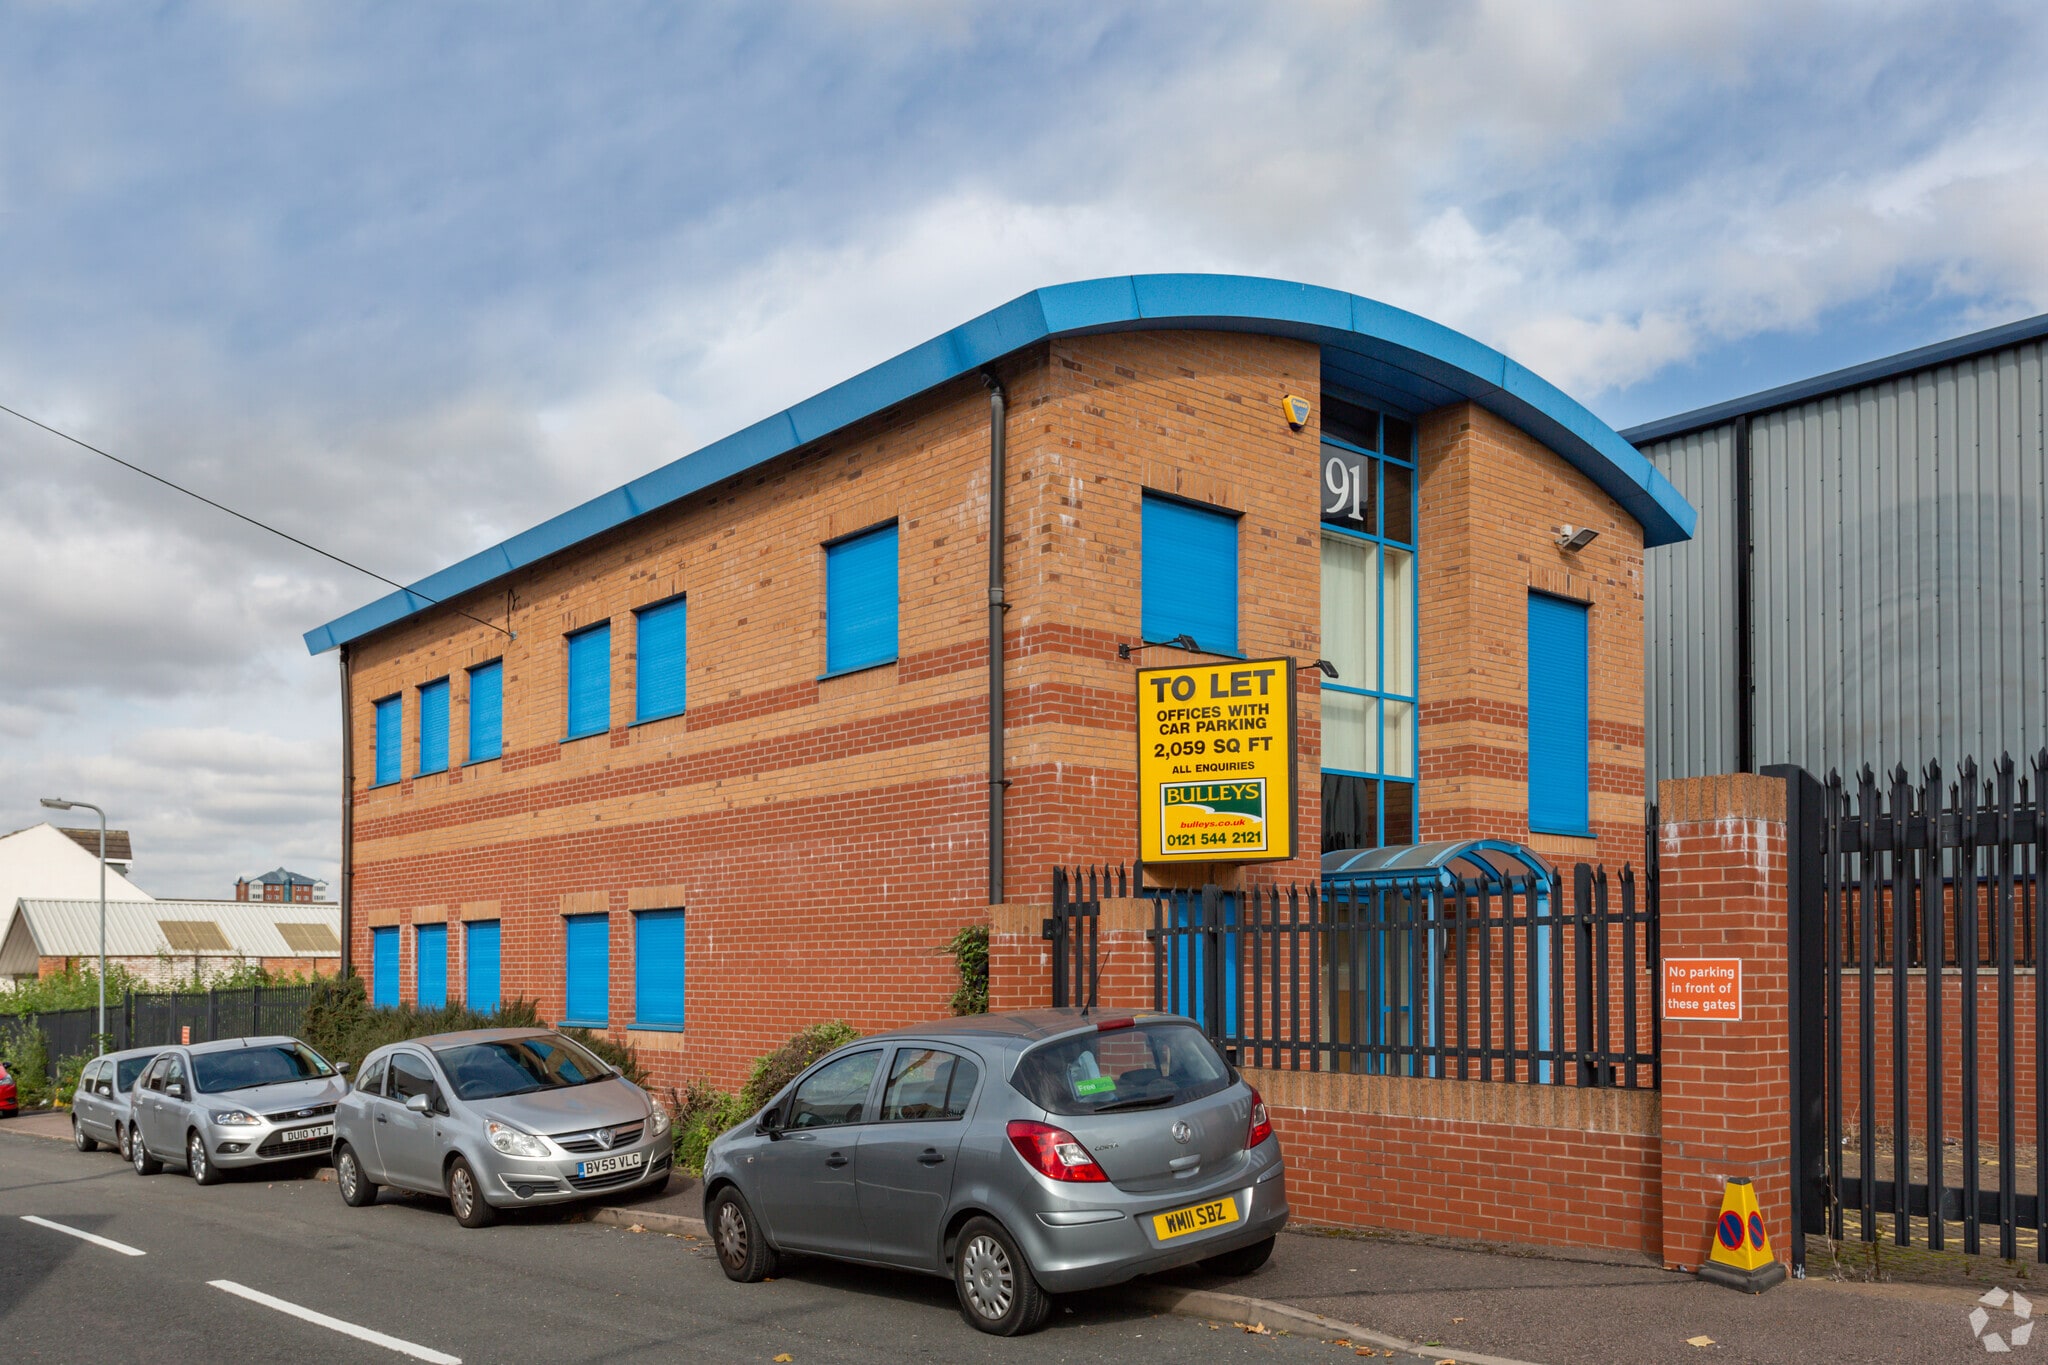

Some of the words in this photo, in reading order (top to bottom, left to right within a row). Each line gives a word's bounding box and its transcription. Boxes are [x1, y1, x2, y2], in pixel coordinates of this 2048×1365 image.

[1325, 457, 1364, 521] 91
[1150, 675, 1196, 703] TO
[1210, 669, 1276, 699] LET
[1156, 706, 1221, 722] OFFICES
[1228, 703, 1270, 717] WITH
[1159, 722, 1190, 735] CAR
[1196, 717, 1267, 733] PARKING
[1154, 740, 1206, 760] 2,059
[1213, 738, 1240, 754] SQ
[1248, 736, 1273, 752] FT
[1172, 763, 1192, 774] ALL
[1195, 761, 1255, 773] ENQUIRIES
[1167, 783, 1260, 804] BULLEYS
[1180, 818, 1245, 829] bulleys.co.uk
[1167, 834, 1196, 846] 0121
[1201, 832, 1227, 844] 544
[1232, 831, 1261, 844] 2121
[1669, 966, 1686, 977] No
[1689, 966, 1735, 980] parking
[1671, 982, 1682, 993] in
[1685, 982, 1715, 993] front
[1719, 983, 1732, 994] of
[1667, 998, 1699, 1009] these
[1702, 999, 1736, 1011] gates
[287, 1129, 308, 1140] DU10
[310, 1126, 329, 1137] YTJ
[586, 1158, 616, 1174] BV59
[618, 1154, 640, 1168] VLC
[1165, 1210, 1195, 1233] WM11
[1196, 1202, 1226, 1225] SBZ
